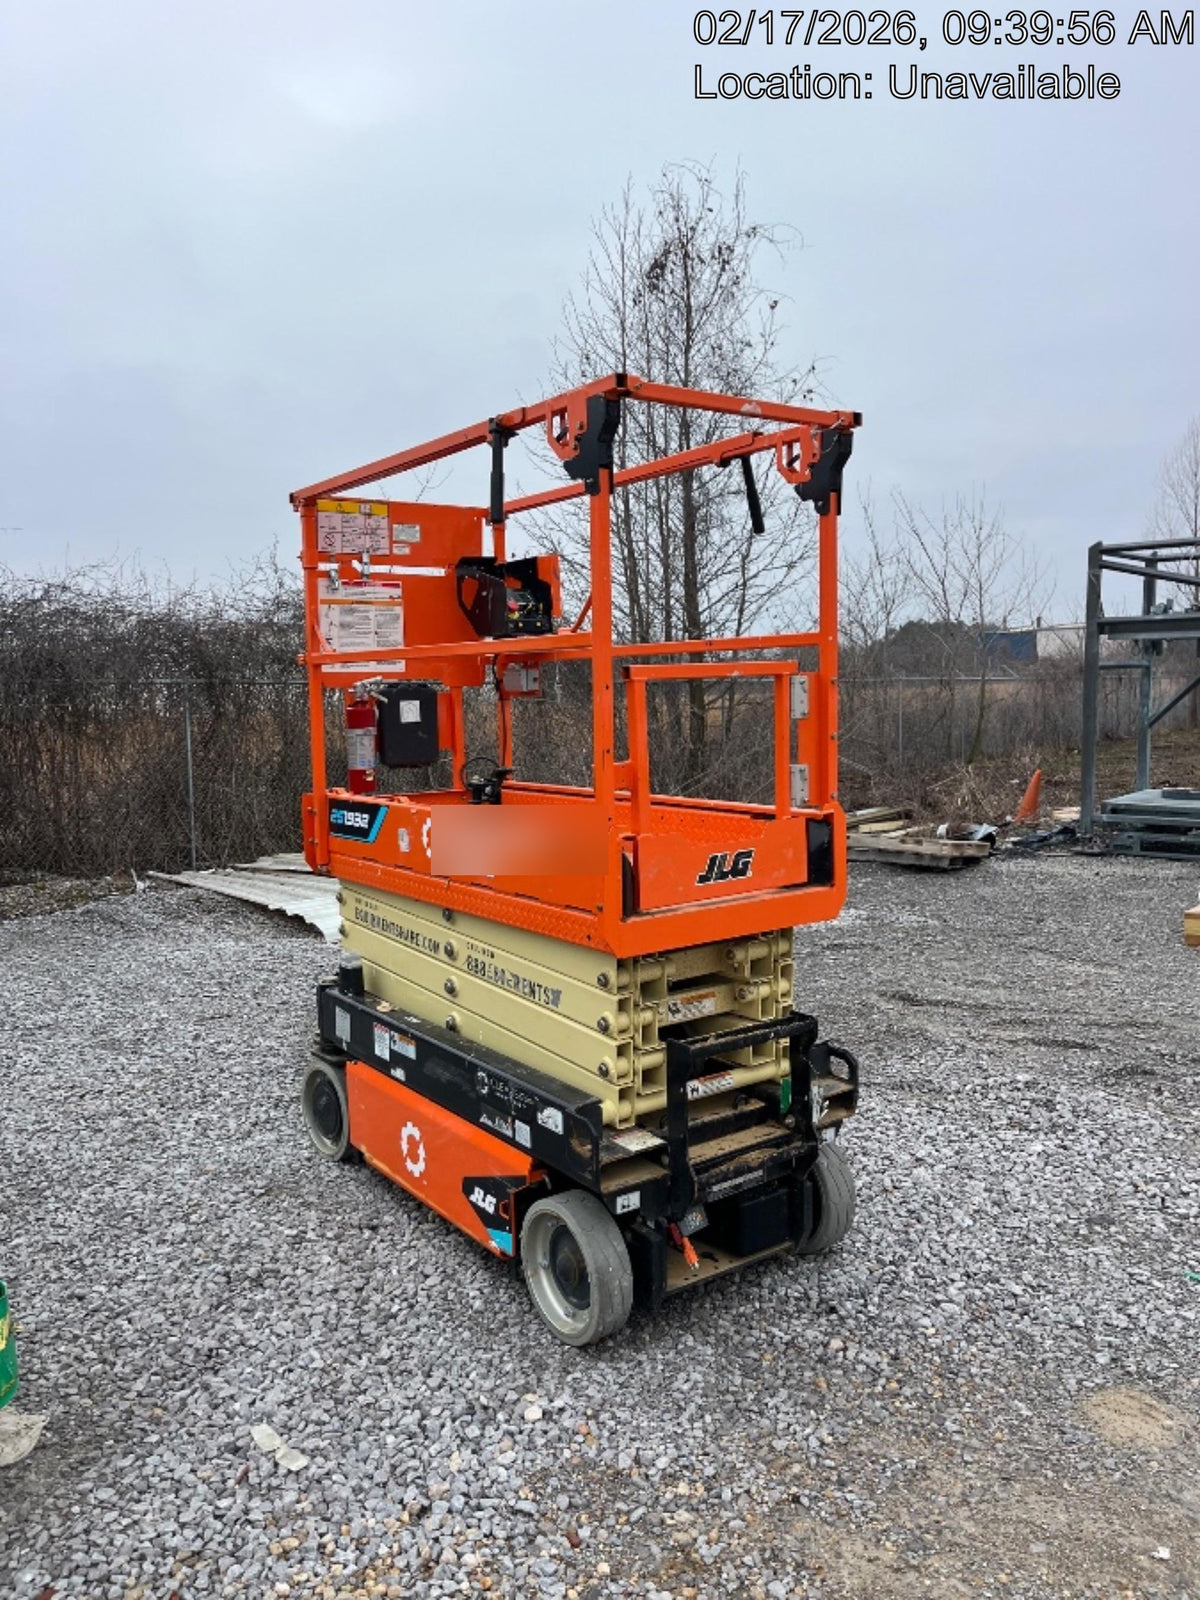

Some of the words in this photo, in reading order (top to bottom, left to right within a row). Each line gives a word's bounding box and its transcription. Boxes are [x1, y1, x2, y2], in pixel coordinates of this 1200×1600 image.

[695, 847, 755, 886] JLG
[355, 906, 440, 954] EQUPMENTSHARECOM
[469, 1185, 497, 1215] JLG
